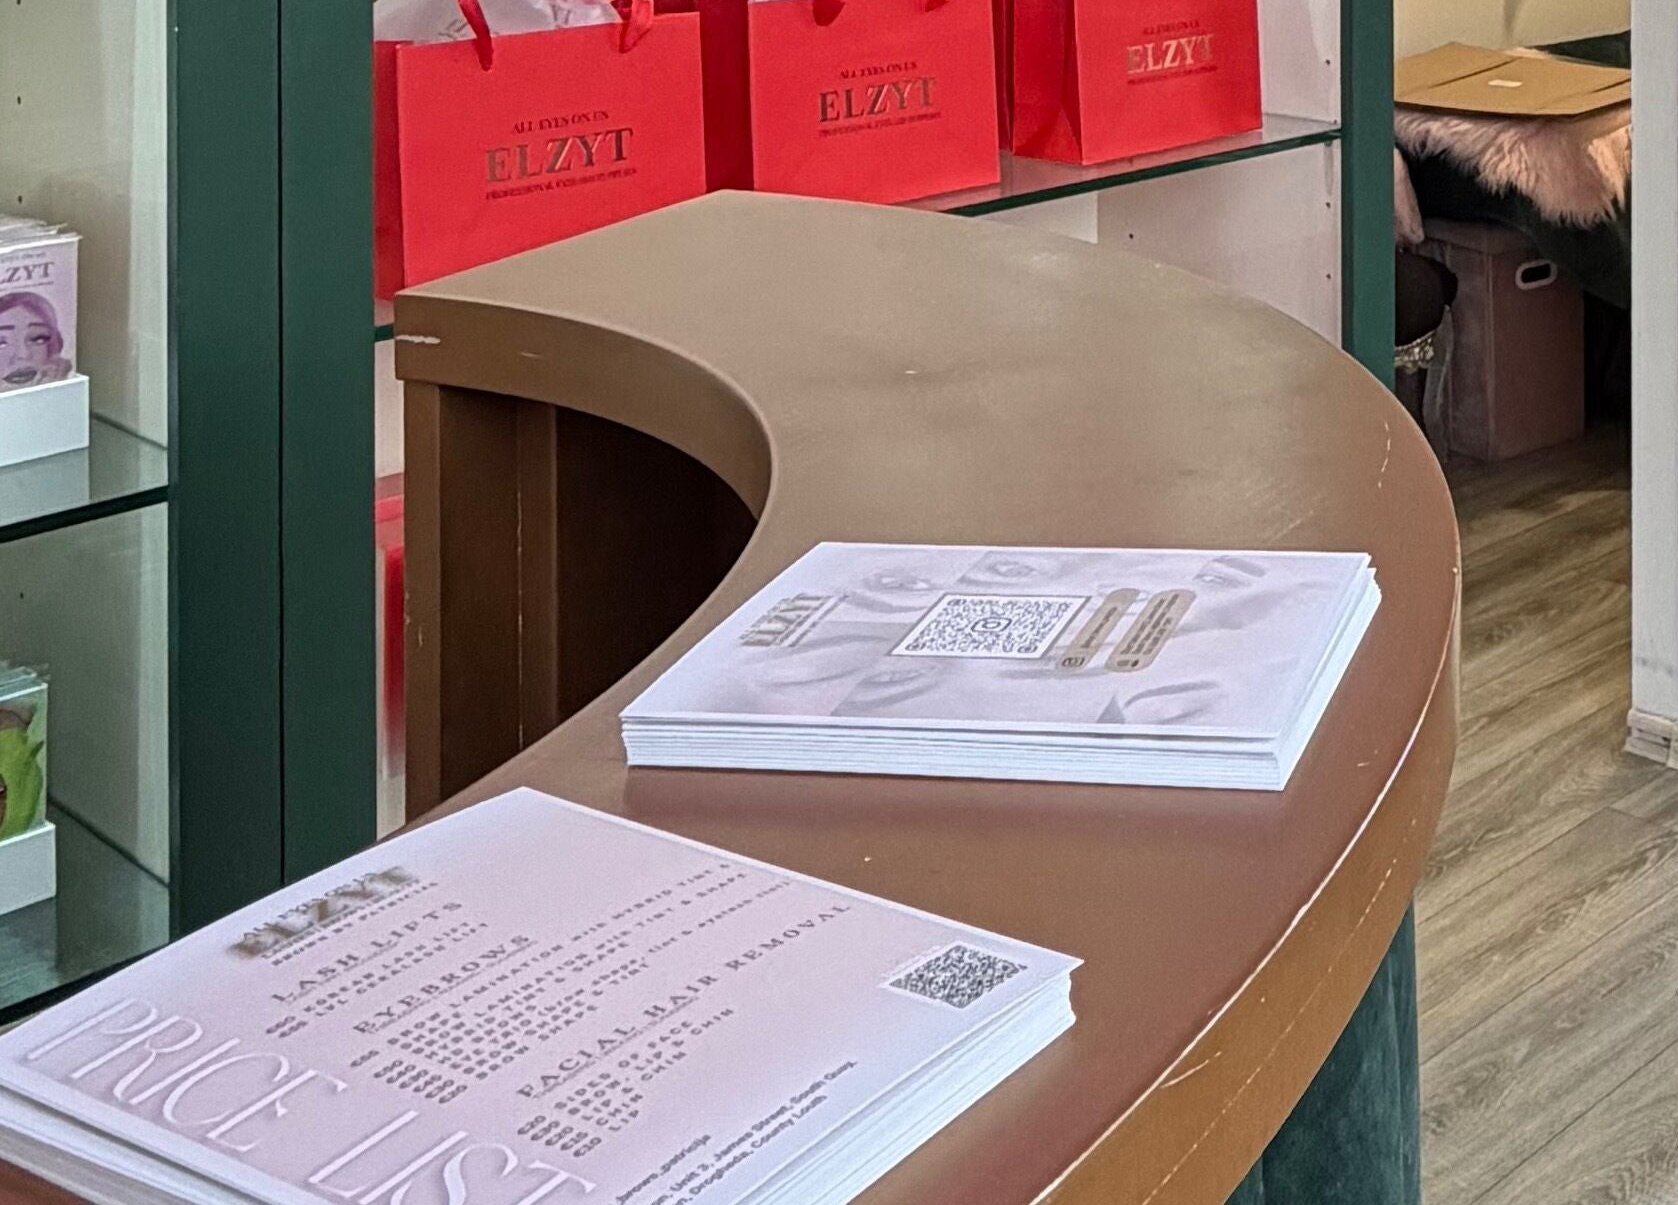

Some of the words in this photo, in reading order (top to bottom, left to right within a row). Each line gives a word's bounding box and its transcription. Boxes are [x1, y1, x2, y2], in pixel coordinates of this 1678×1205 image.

[819, 76, 936, 123] ELZYT
[1126, 33, 1214, 74] ELZYT
[485, 127, 634, 184] ELZYT
[271, 954, 359, 1002] LASH
[370, 902, 462, 949] LIFTS
[303, 972, 381, 1013] KOREAN
[381, 944, 427, 970] LASH
[432, 921, 469, 942] LIFT
[352, 935, 531, 1034] EYEBROWS
[386, 1011, 441, 1046] BROW
[448, 944, 564, 1009] LAMINATION
[676, 869, 712, 887] TINT
[410, 1021, 466, 1055] BROW
[473, 953, 588, 1018] LAMINATION
[635, 907, 673, 928] TINT
[696, 873, 746, 898] SHAPE
[419, 1016, 501, 1060] HYBRID
[502, 987, 545, 1012] TINT
[572, 942, 629, 972] SHAPE
[399, 1011, 462, 1051] SHAPE
[449, 1048, 484, 1071] EYE
[489, 1019, 532, 1045] TRIO
[462, 1040, 517, 1075] BROW
[523, 1000, 586, 1037] SHAPE
[609, 962, 649, 985] TINT
[471, 1004, 537, 1044] BROWS
[516, 1026, 642, 1098] FACIAL
[643, 975, 718, 1018] HAIR
[724, 906, 851, 971] REMOVAL
[27, 997, 348, 1152] PRICE
[438, 1084, 468, 1105] €20
[475, 1045, 530, 1081] BROW
[537, 1005, 598, 1042] SHAPE
[516, 1115, 547, 1136] €20
[553, 1072, 612, 1110] SIDES
[617, 1052, 639, 1069] OF
[647, 1021, 692, 1049] FACE
[530, 1120, 561, 1142] €30
[567, 1077, 630, 1116] BROW,
[634, 1050, 663, 1072] LIP
[671, 1040, 685, 1048] &
[690, 1008, 734, 1036] CHIN
[544, 1126, 574, 1147] €20
[580, 1098, 612, 1122] LIP
[640, 1051, 687, 1081] CHIN
[307, 1109, 597, 1205] LIST
[559, 1131, 589, 1152] €15
[595, 1093, 644, 1127] CHIN
[572, 1137, 602, 1158] €10
[607, 1109, 640, 1132] LIP
[669, 1171, 701, 1192] Unit
[713, 1131, 754, 1162] James
[751, 1105, 794, 1132] Street,
[789, 1080, 827, 1105] South
[687, 1150, 756, 1196] Drogheda,
[750, 1118, 796, 1149] County
[791, 1095, 828, 1120] Louth
